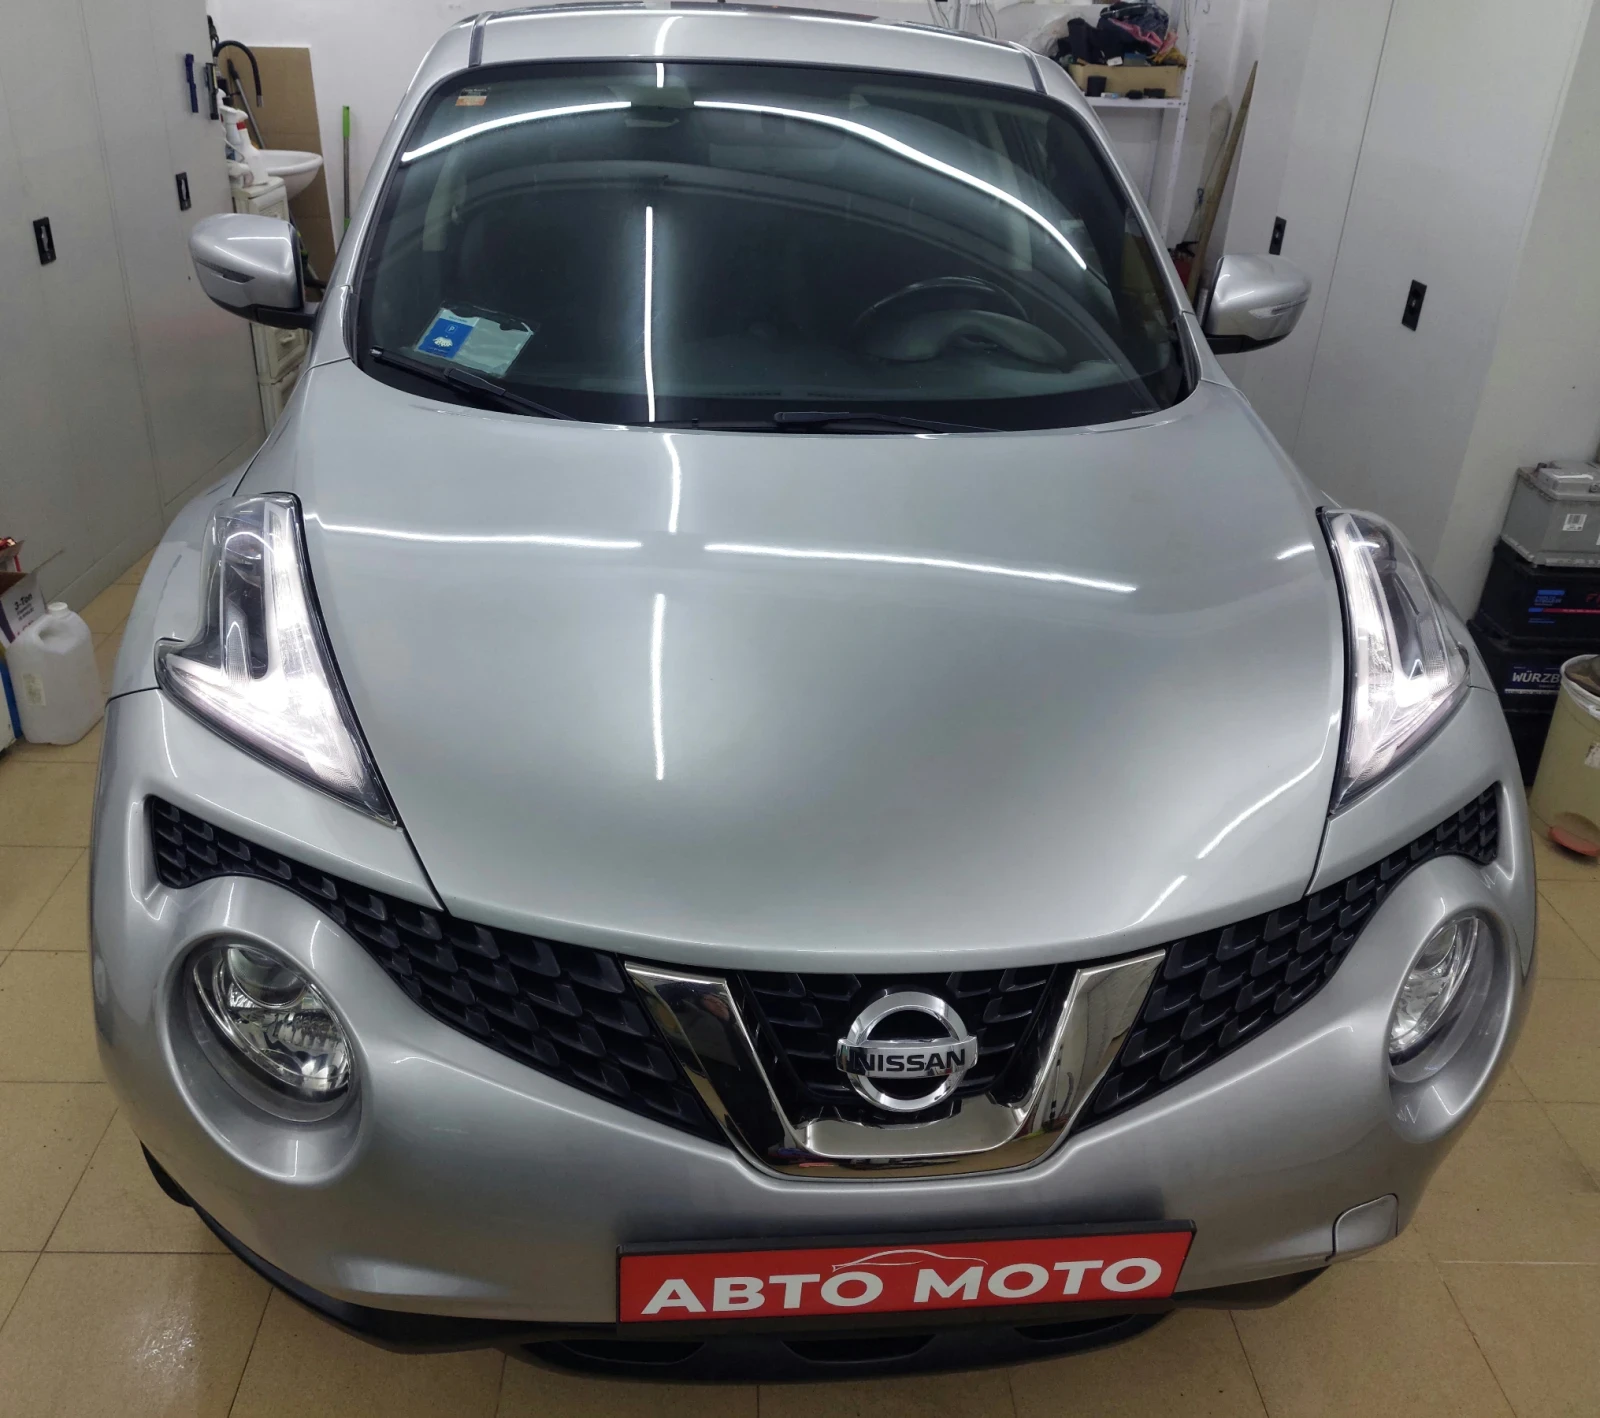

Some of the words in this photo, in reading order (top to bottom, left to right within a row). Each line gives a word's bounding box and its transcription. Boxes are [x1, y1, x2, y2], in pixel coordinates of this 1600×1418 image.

[853, 1049, 965, 1072] NISSAN
[641, 1271, 883, 1315] АВТО
[913, 1257, 1162, 1303] МОТО
